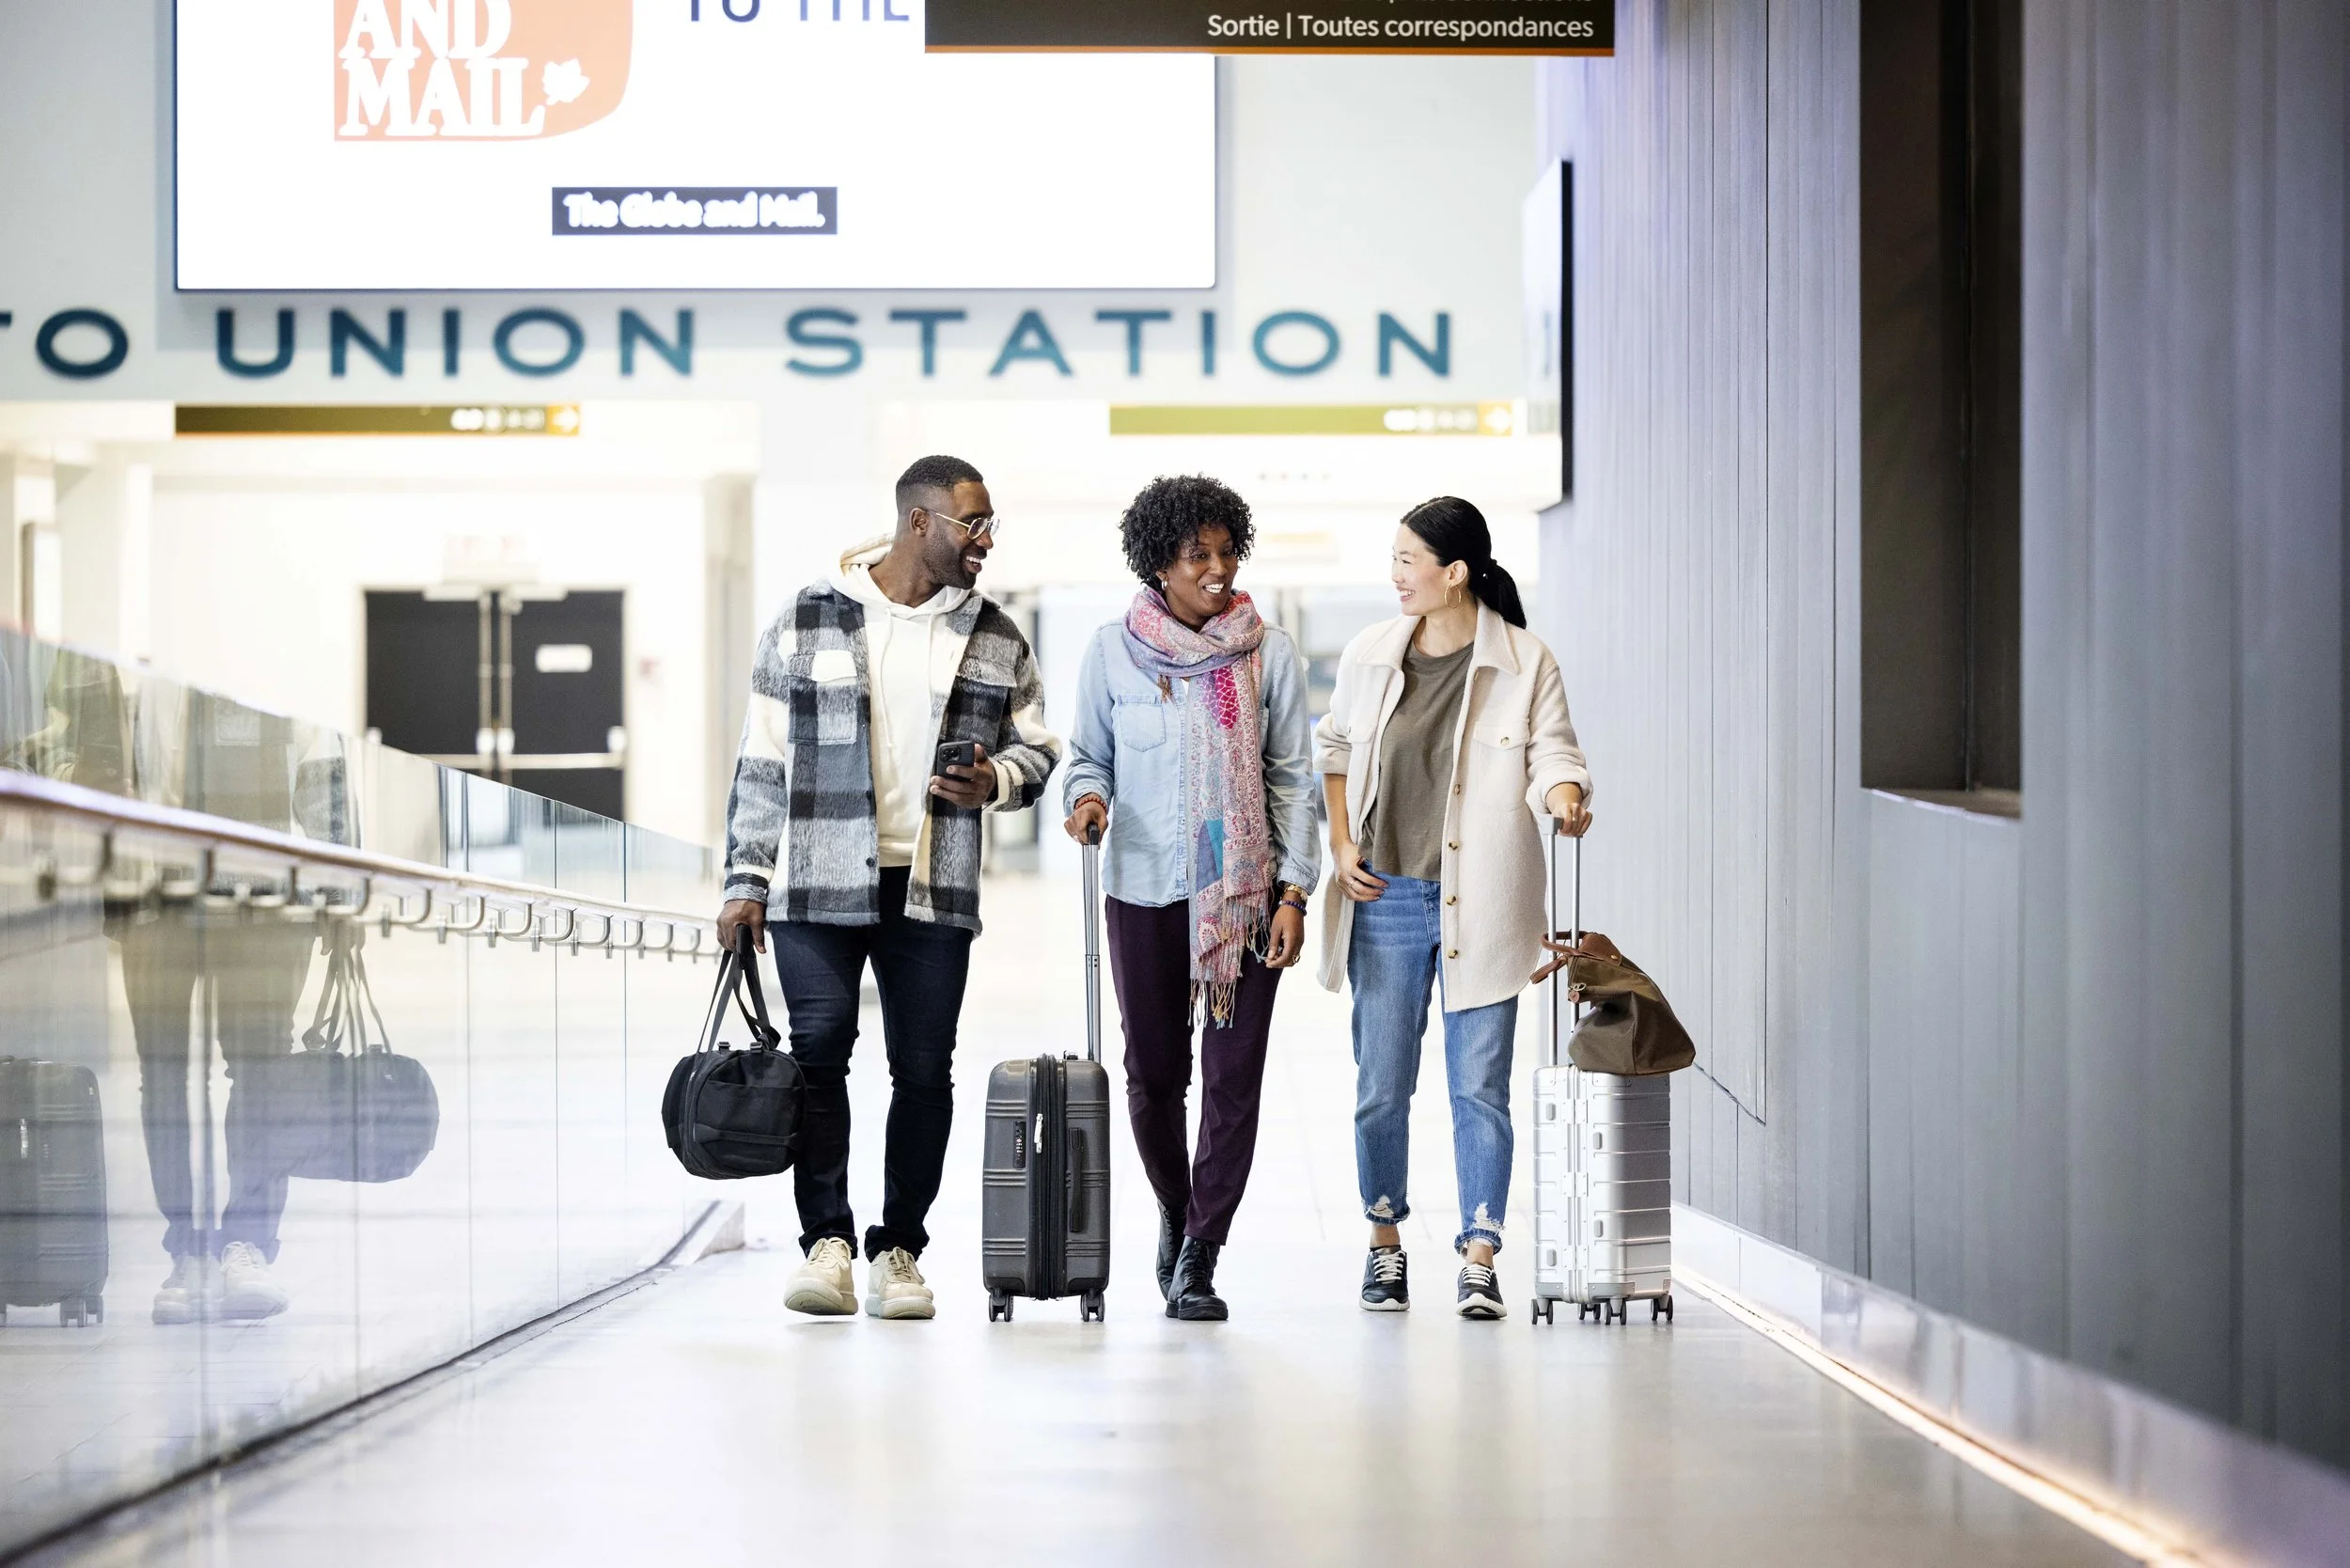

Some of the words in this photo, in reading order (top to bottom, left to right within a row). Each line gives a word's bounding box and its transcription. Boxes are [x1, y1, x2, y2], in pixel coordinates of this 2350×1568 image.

[337, 0, 512, 58] AND
[1207, 13, 1280, 37] Sortie
[1297, 13, 1380, 38] Toutes
[1384, 14, 1594, 42] correspondances
[337, 56, 547, 136] MAIL
[562, 191, 619, 227] The
[0, 308, 130, 380] O
[215, 306, 696, 378] UNION
[785, 306, 1450, 378] STATION
